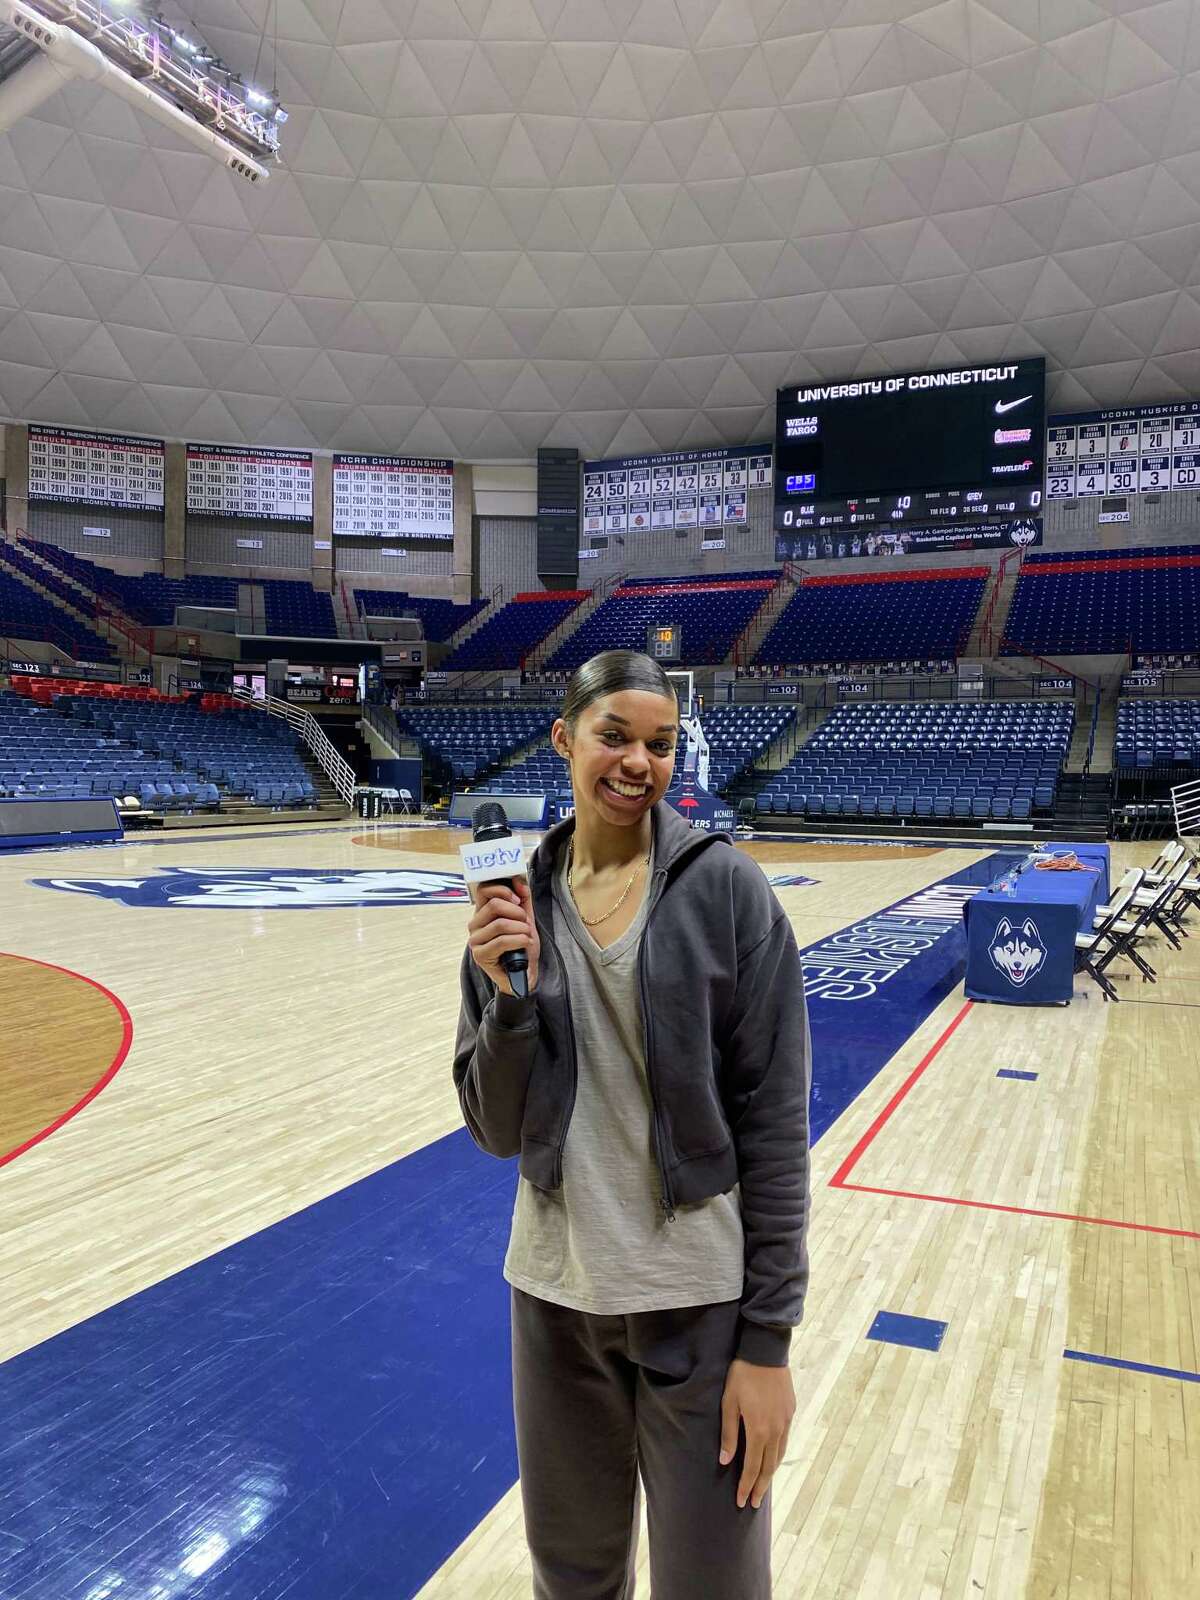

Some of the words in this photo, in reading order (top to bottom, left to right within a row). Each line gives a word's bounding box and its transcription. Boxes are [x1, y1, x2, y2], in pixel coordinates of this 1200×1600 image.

[798, 380, 882, 403] UNIVERSITY
[885, 378, 905, 392] OF
[908, 365, 1019, 389] CONNECTICUT
[1101, 409, 1136, 419] UCONN
[1141, 405, 1186, 415] HUSKIES
[786, 416, 818, 427] WELLS
[786, 425, 818, 436] FARGO
[1149, 433, 1162, 448] 20
[1182, 430, 1193, 445] 31
[1056, 442, 1067, 456] 32
[1089, 439, 1095, 453] 3
[340, 456, 367, 464] NCAA
[372, 458, 447, 467] CHAMPIONSHIP
[705, 474, 717, 487] 25
[730, 472, 740, 485] 33
[756, 469, 765, 482] 10
[786, 474, 812, 485] CBS
[1113, 473, 1131, 488] 30
[1150, 471, 1159, 485] 3
[1177, 469, 1196, 483] CD
[609, 483, 624, 496] 50
[634, 482, 646, 494] 21
[656, 479, 670, 491] 52
[679, 477, 695, 489] 42
[1051, 478, 1069, 493] 23
[1086, 476, 1095, 490] 4
[587, 485, 602, 498] 24
[1031, 491, 1041, 506] 0
[783, 510, 793, 526] 0
[24, 663, 40, 673] 123
[850, 684, 868, 692] 104
[1052, 680, 1072, 688] 104
[1137, 678, 1157, 686] 105
[781, 686, 797, 694] 102
[713, 809, 734, 818] MICHAELS
[465, 847, 521, 870] uctv
